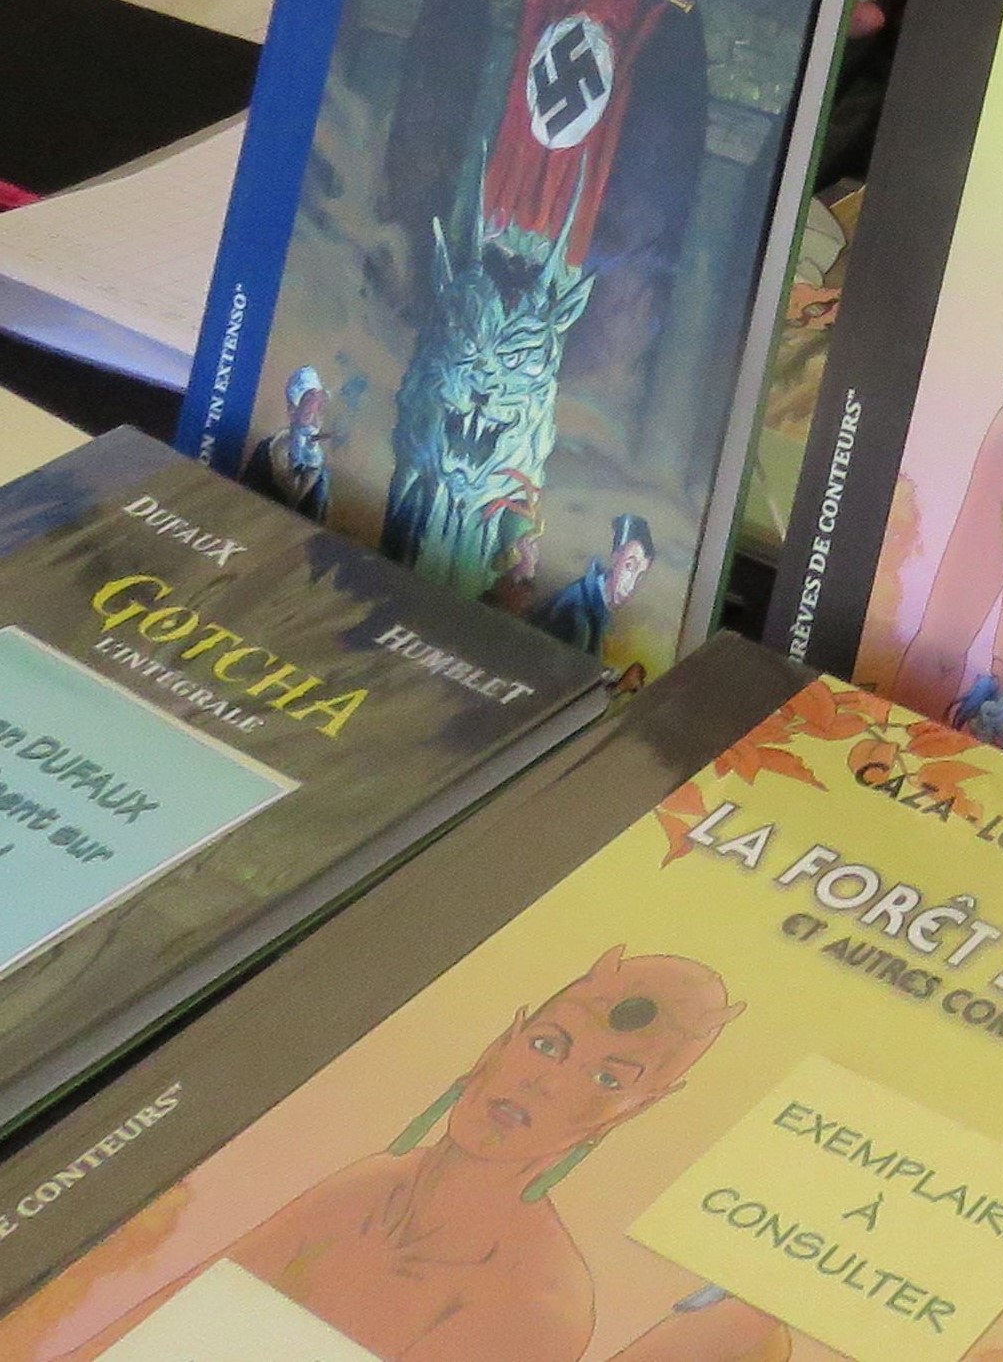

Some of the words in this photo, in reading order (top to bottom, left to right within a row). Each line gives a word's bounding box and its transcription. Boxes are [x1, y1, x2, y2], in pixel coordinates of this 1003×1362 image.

[123, 495, 248, 568] DUFAUX
[809, 537, 831, 575] DE
[90, 574, 374, 739] GOTCHA
[376, 624, 535, 705] HUMBLET
[16, 736, 160, 825] DUFAUX
[855, 761, 956, 824] CAZA
[687, 802, 776, 869] LA
[776, 843, 1002, 962] FORÊT
[781, 912, 823, 946] ET
[822, 932, 944, 999] AUTRES
[842, 1191, 884, 1233] À
[701, 1186, 956, 1335] CONSULTER
